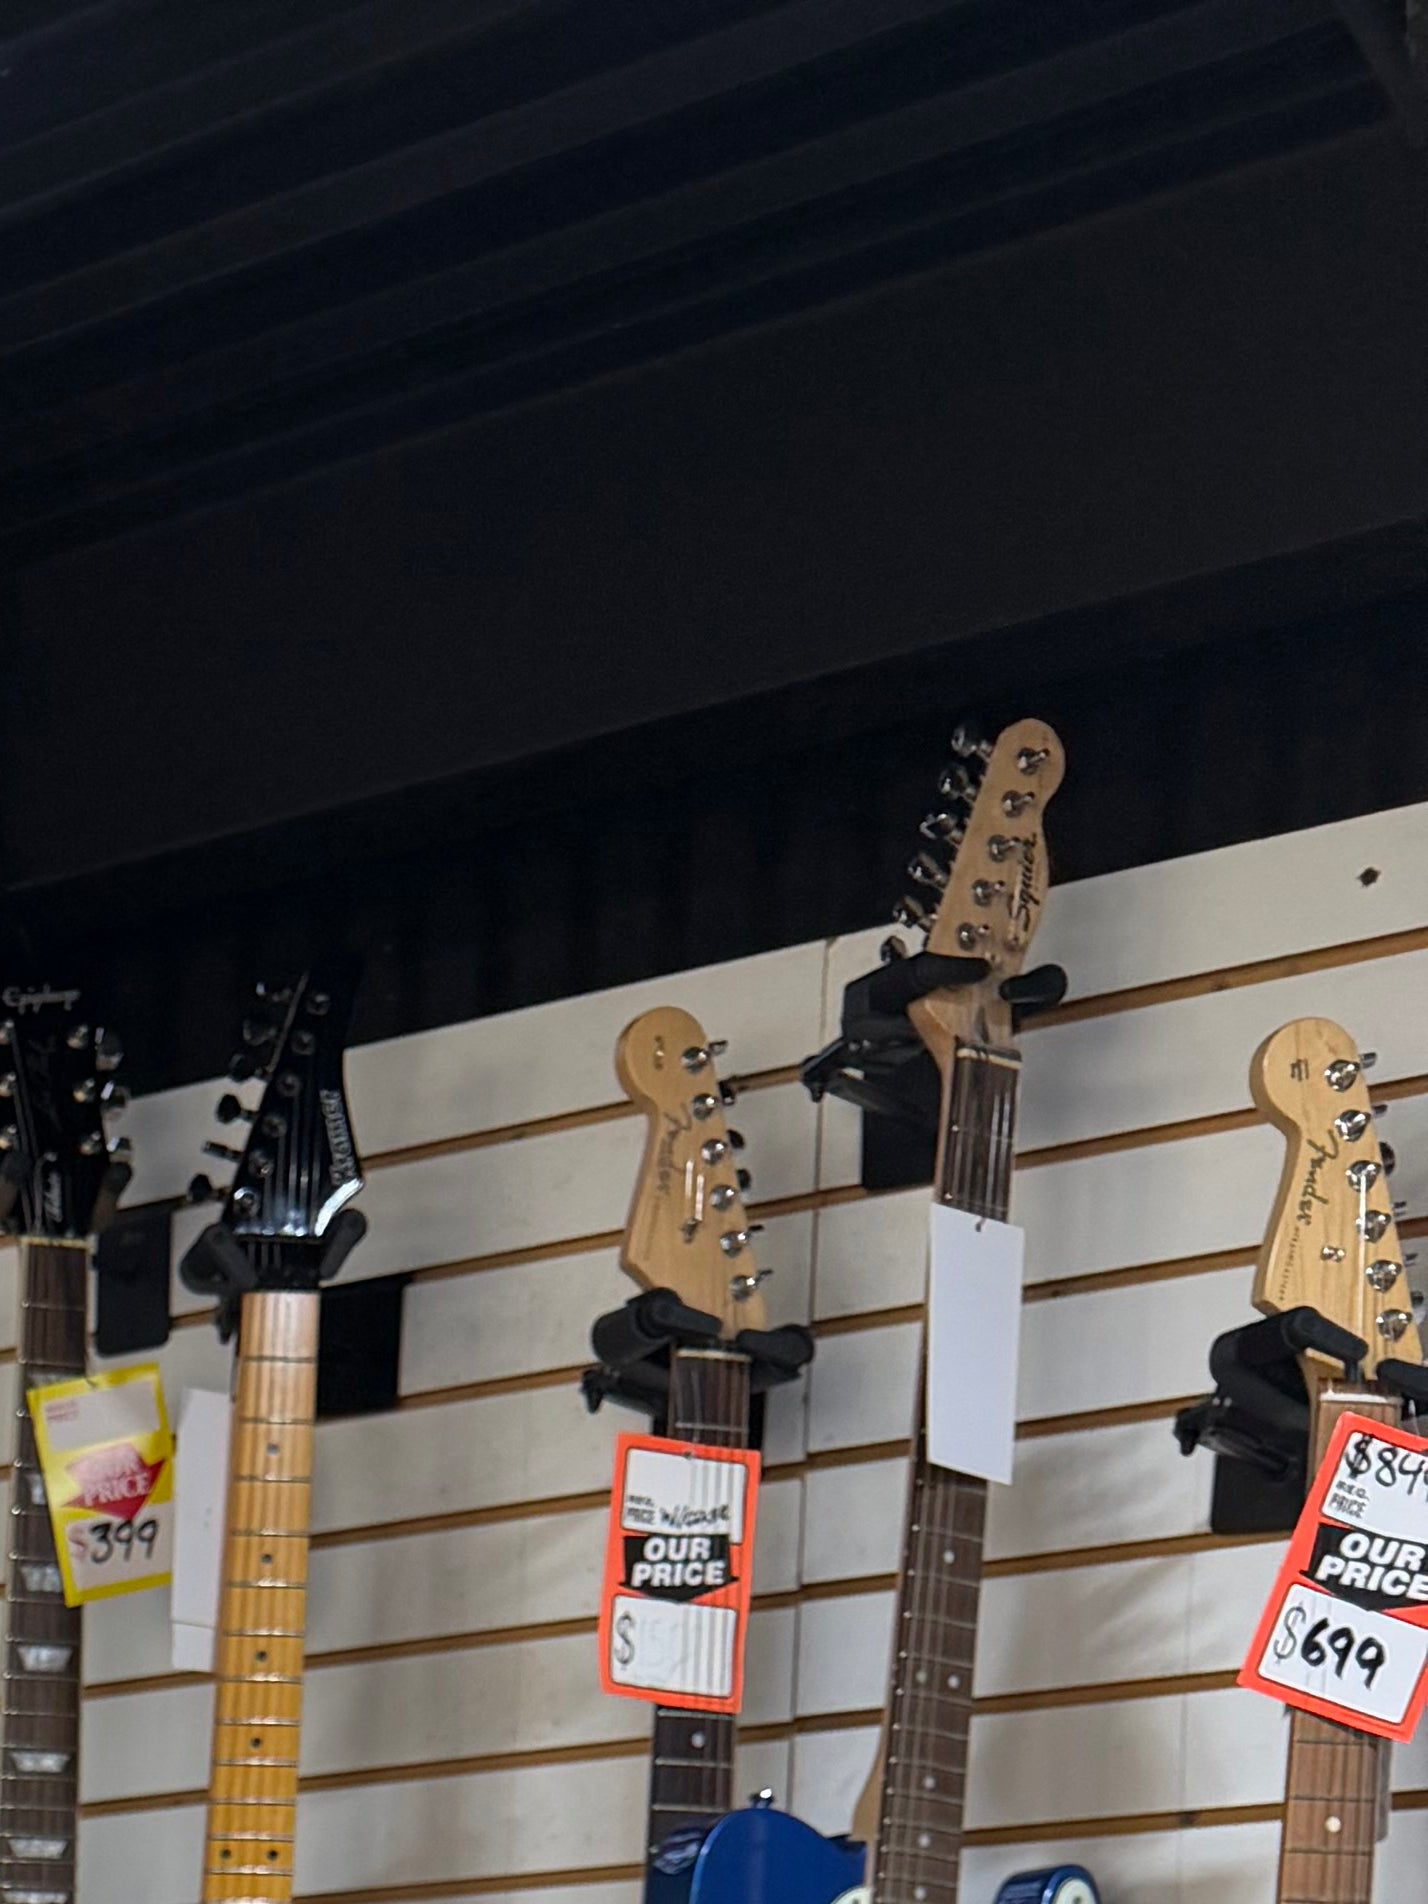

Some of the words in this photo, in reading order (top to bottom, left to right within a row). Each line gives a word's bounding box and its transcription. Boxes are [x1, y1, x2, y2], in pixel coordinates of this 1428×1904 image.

[1295, 1129, 1340, 1227] Fender
[1344, 1433, 1428, 1504] $84
[643, 1535, 712, 1562] OUR
[1339, 1532, 1427, 1573] OUR
[631, 1560, 727, 1588] PRICE
[1314, 1554, 1428, 1602] PRICE
[1273, 1603, 1387, 1693] $699
